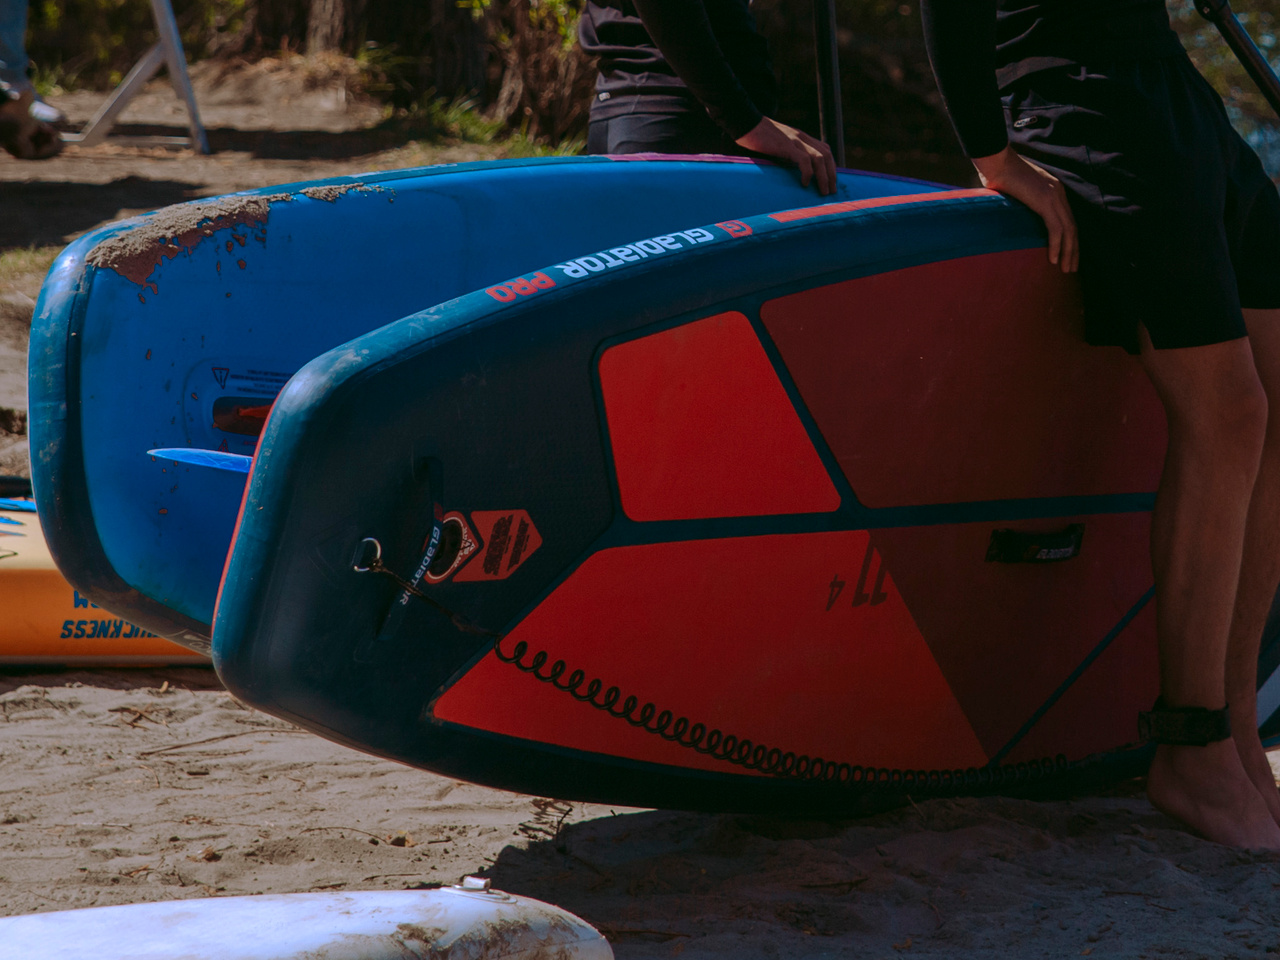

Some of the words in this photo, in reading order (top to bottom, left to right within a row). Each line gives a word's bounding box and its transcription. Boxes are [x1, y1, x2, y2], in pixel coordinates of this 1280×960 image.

[554, 227, 715, 279] GLADIATOR
[485, 271, 557, 303] PRO
[399, 525, 441, 606] GLADIATR
